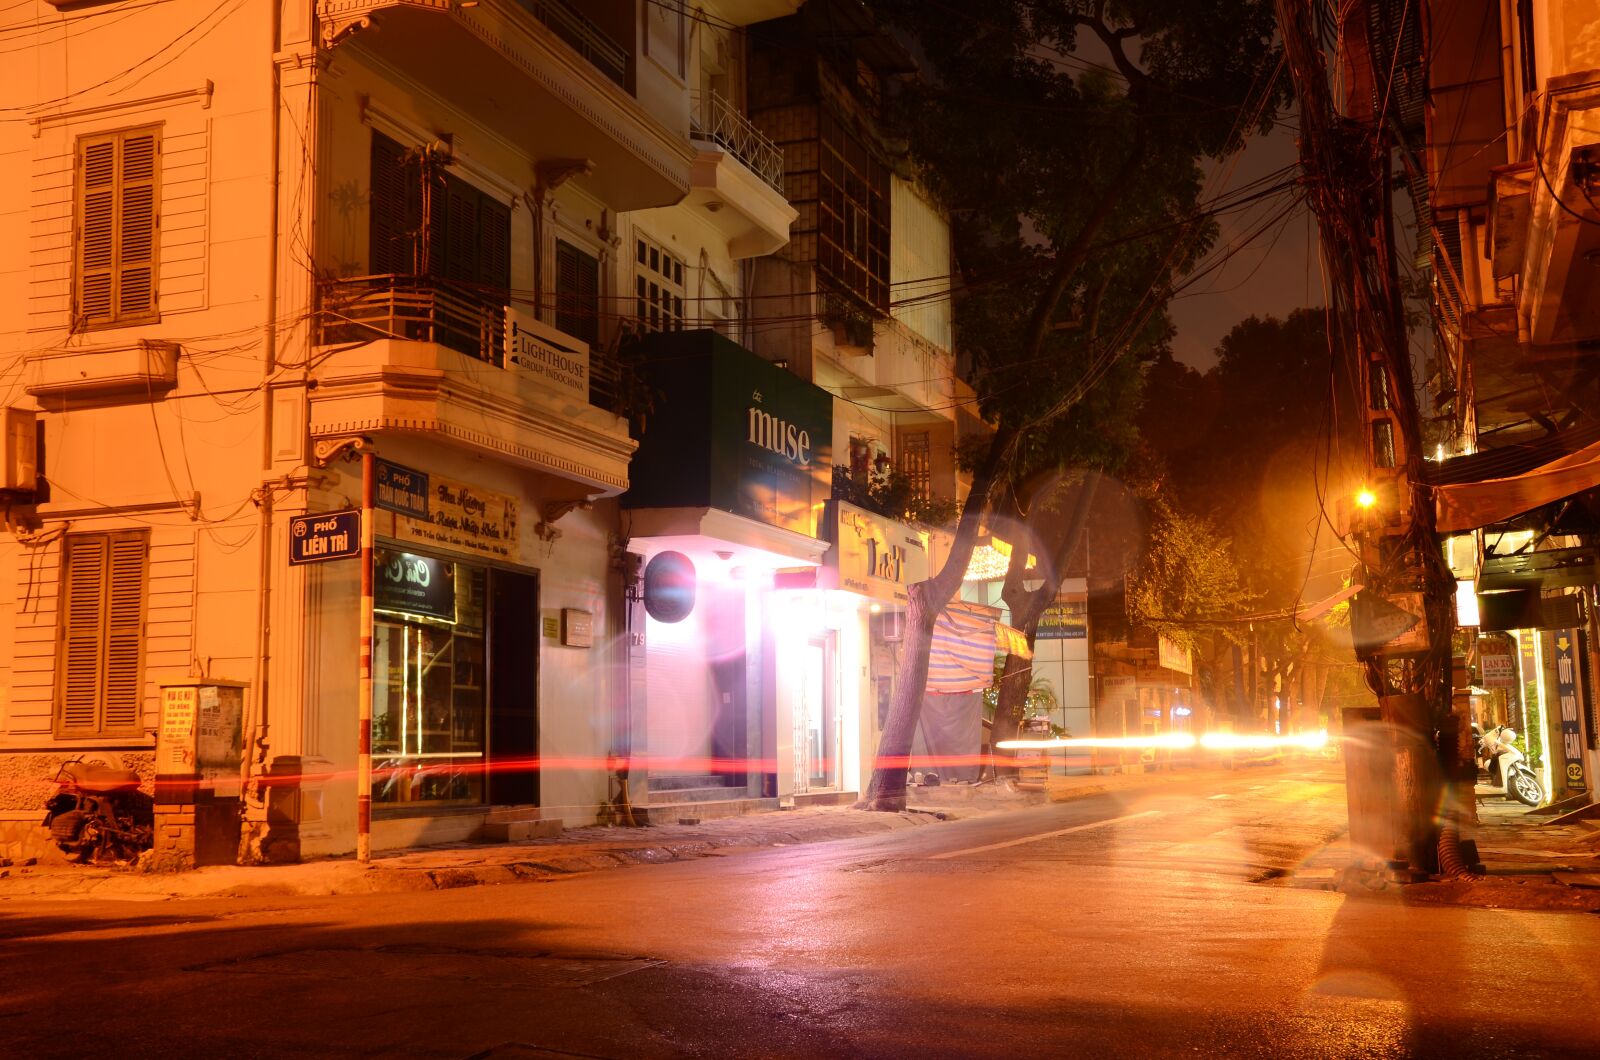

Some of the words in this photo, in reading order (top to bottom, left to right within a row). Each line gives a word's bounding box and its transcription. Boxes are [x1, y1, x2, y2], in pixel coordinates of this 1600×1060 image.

[521, 337, 584, 378] LIGHTHOUSE
[520, 357, 544, 375] GROUP
[545, 367, 584, 391] INDOCHINA
[748, 406, 810, 466] muse
[393, 473, 411, 487] PHỐ
[314, 518, 338, 532] PHỐ
[302, 535, 327, 556] LIÊN
[633, 633, 645, 645] 79
[1568, 766, 1581, 777] 82
